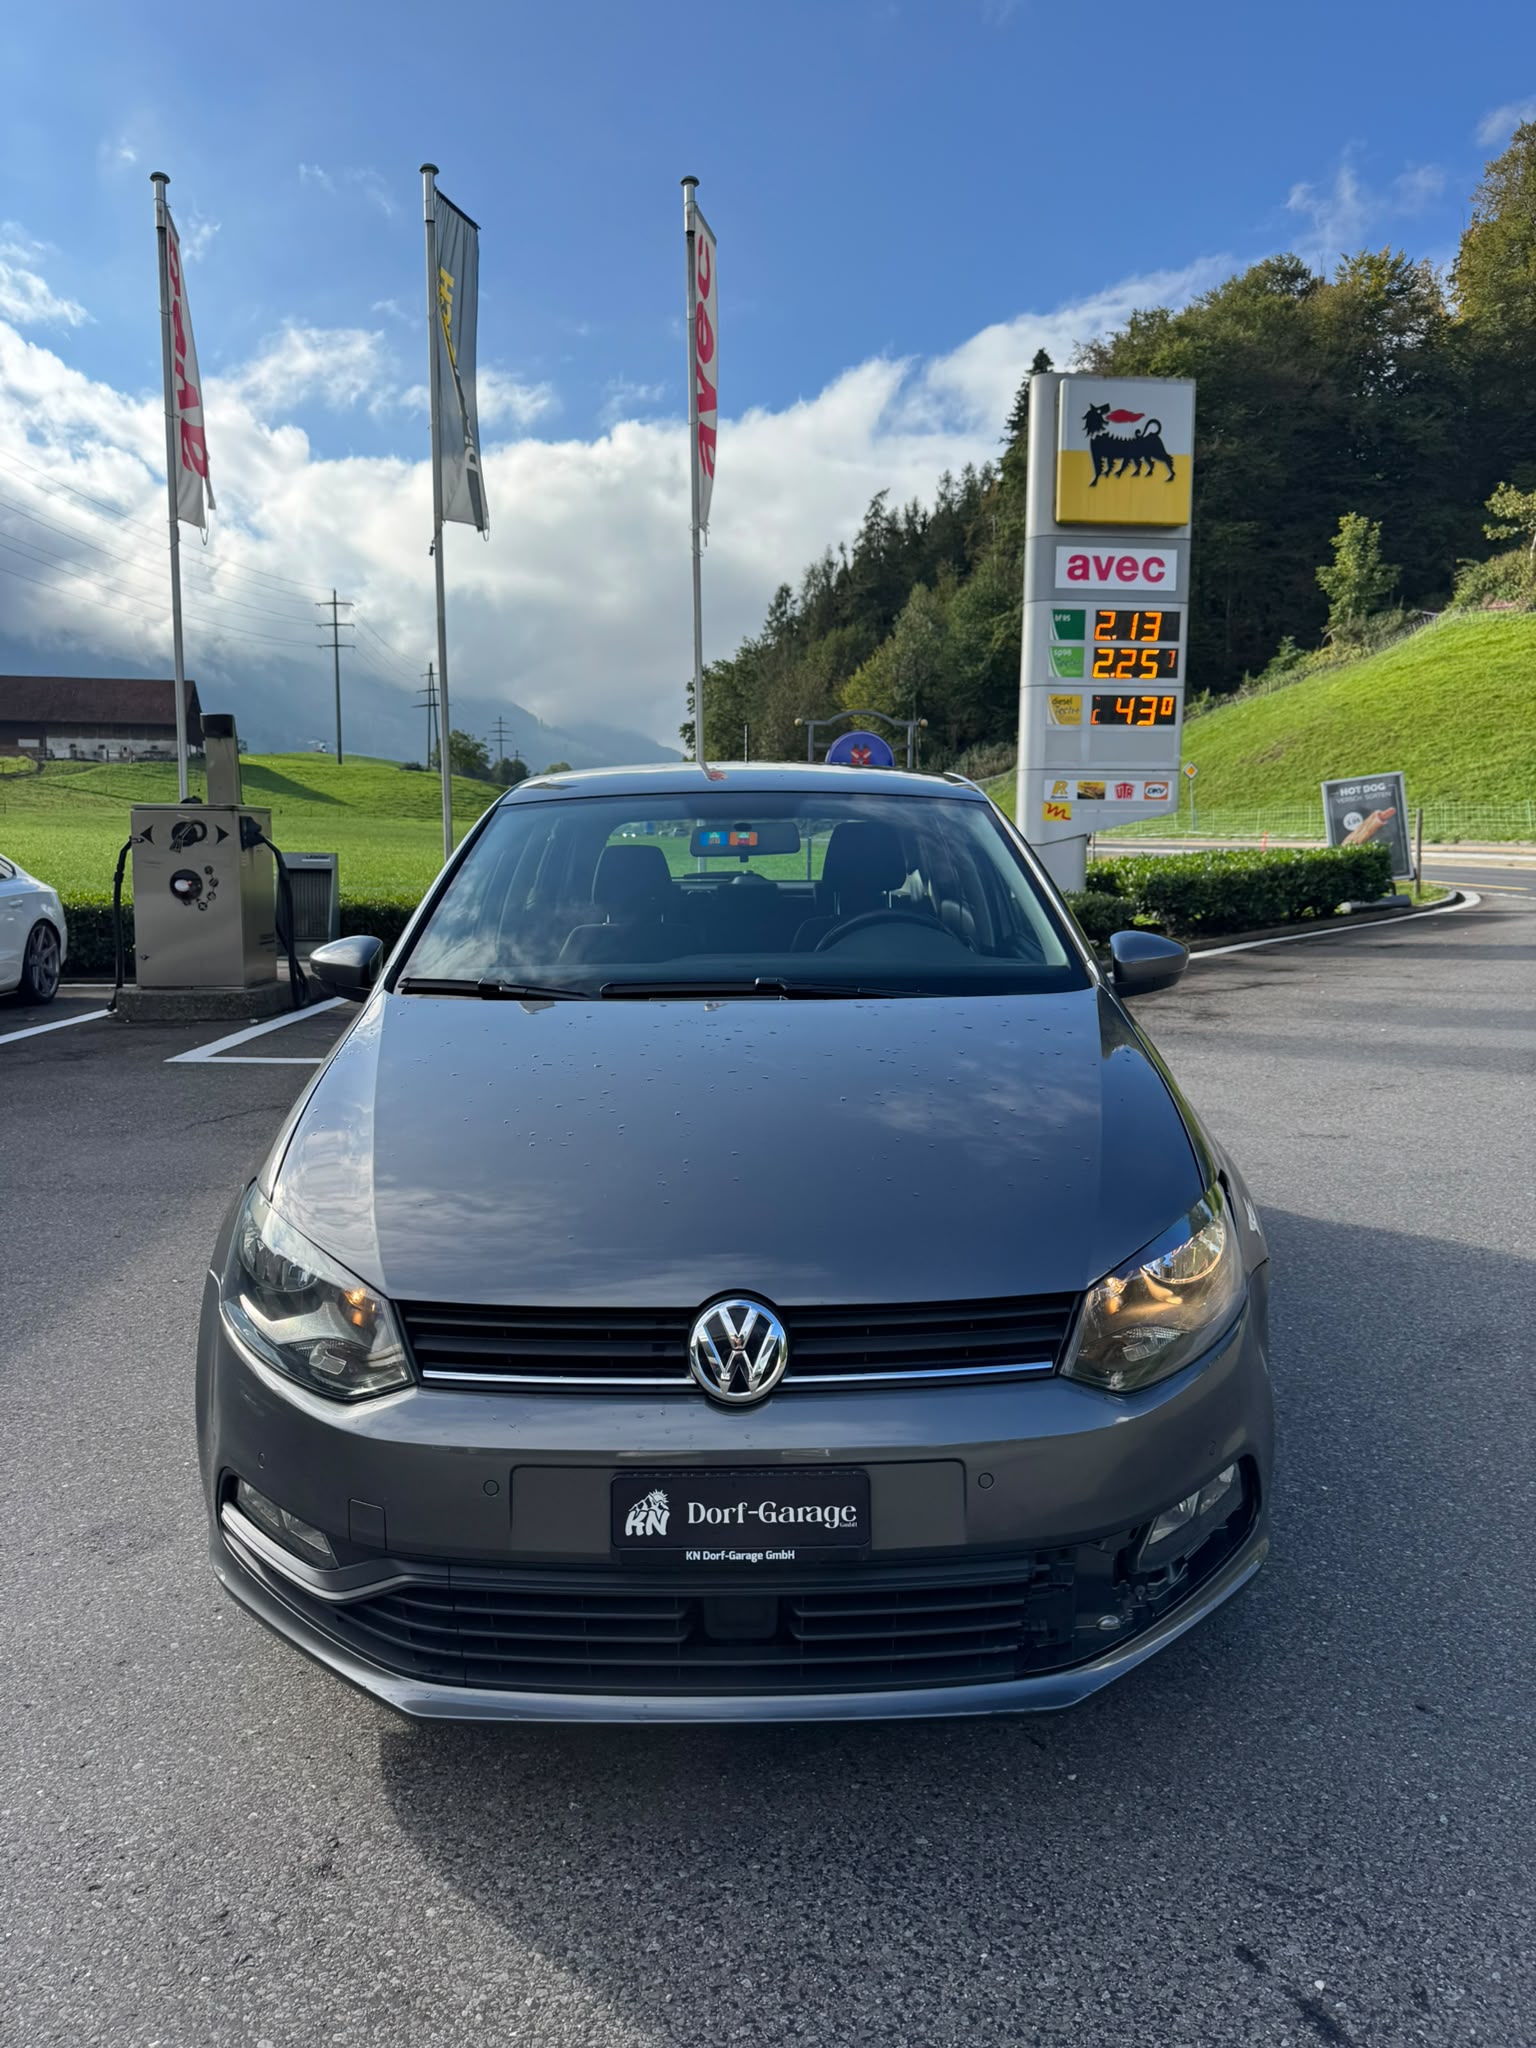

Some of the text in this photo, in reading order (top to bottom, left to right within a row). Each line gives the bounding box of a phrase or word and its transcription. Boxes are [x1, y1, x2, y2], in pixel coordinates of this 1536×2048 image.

[695, 236, 717, 479] avec
[1066, 554, 1166, 583] avec
[1052, 697, 1073, 705] diesel
[1340, 783, 1386, 797] HOT DOG
[625, 1508, 670, 1537] KN
[687, 1500, 857, 1529] Dorf-Garage
[685, 1550, 795, 1563] KN Dorf-Garage GmbH
